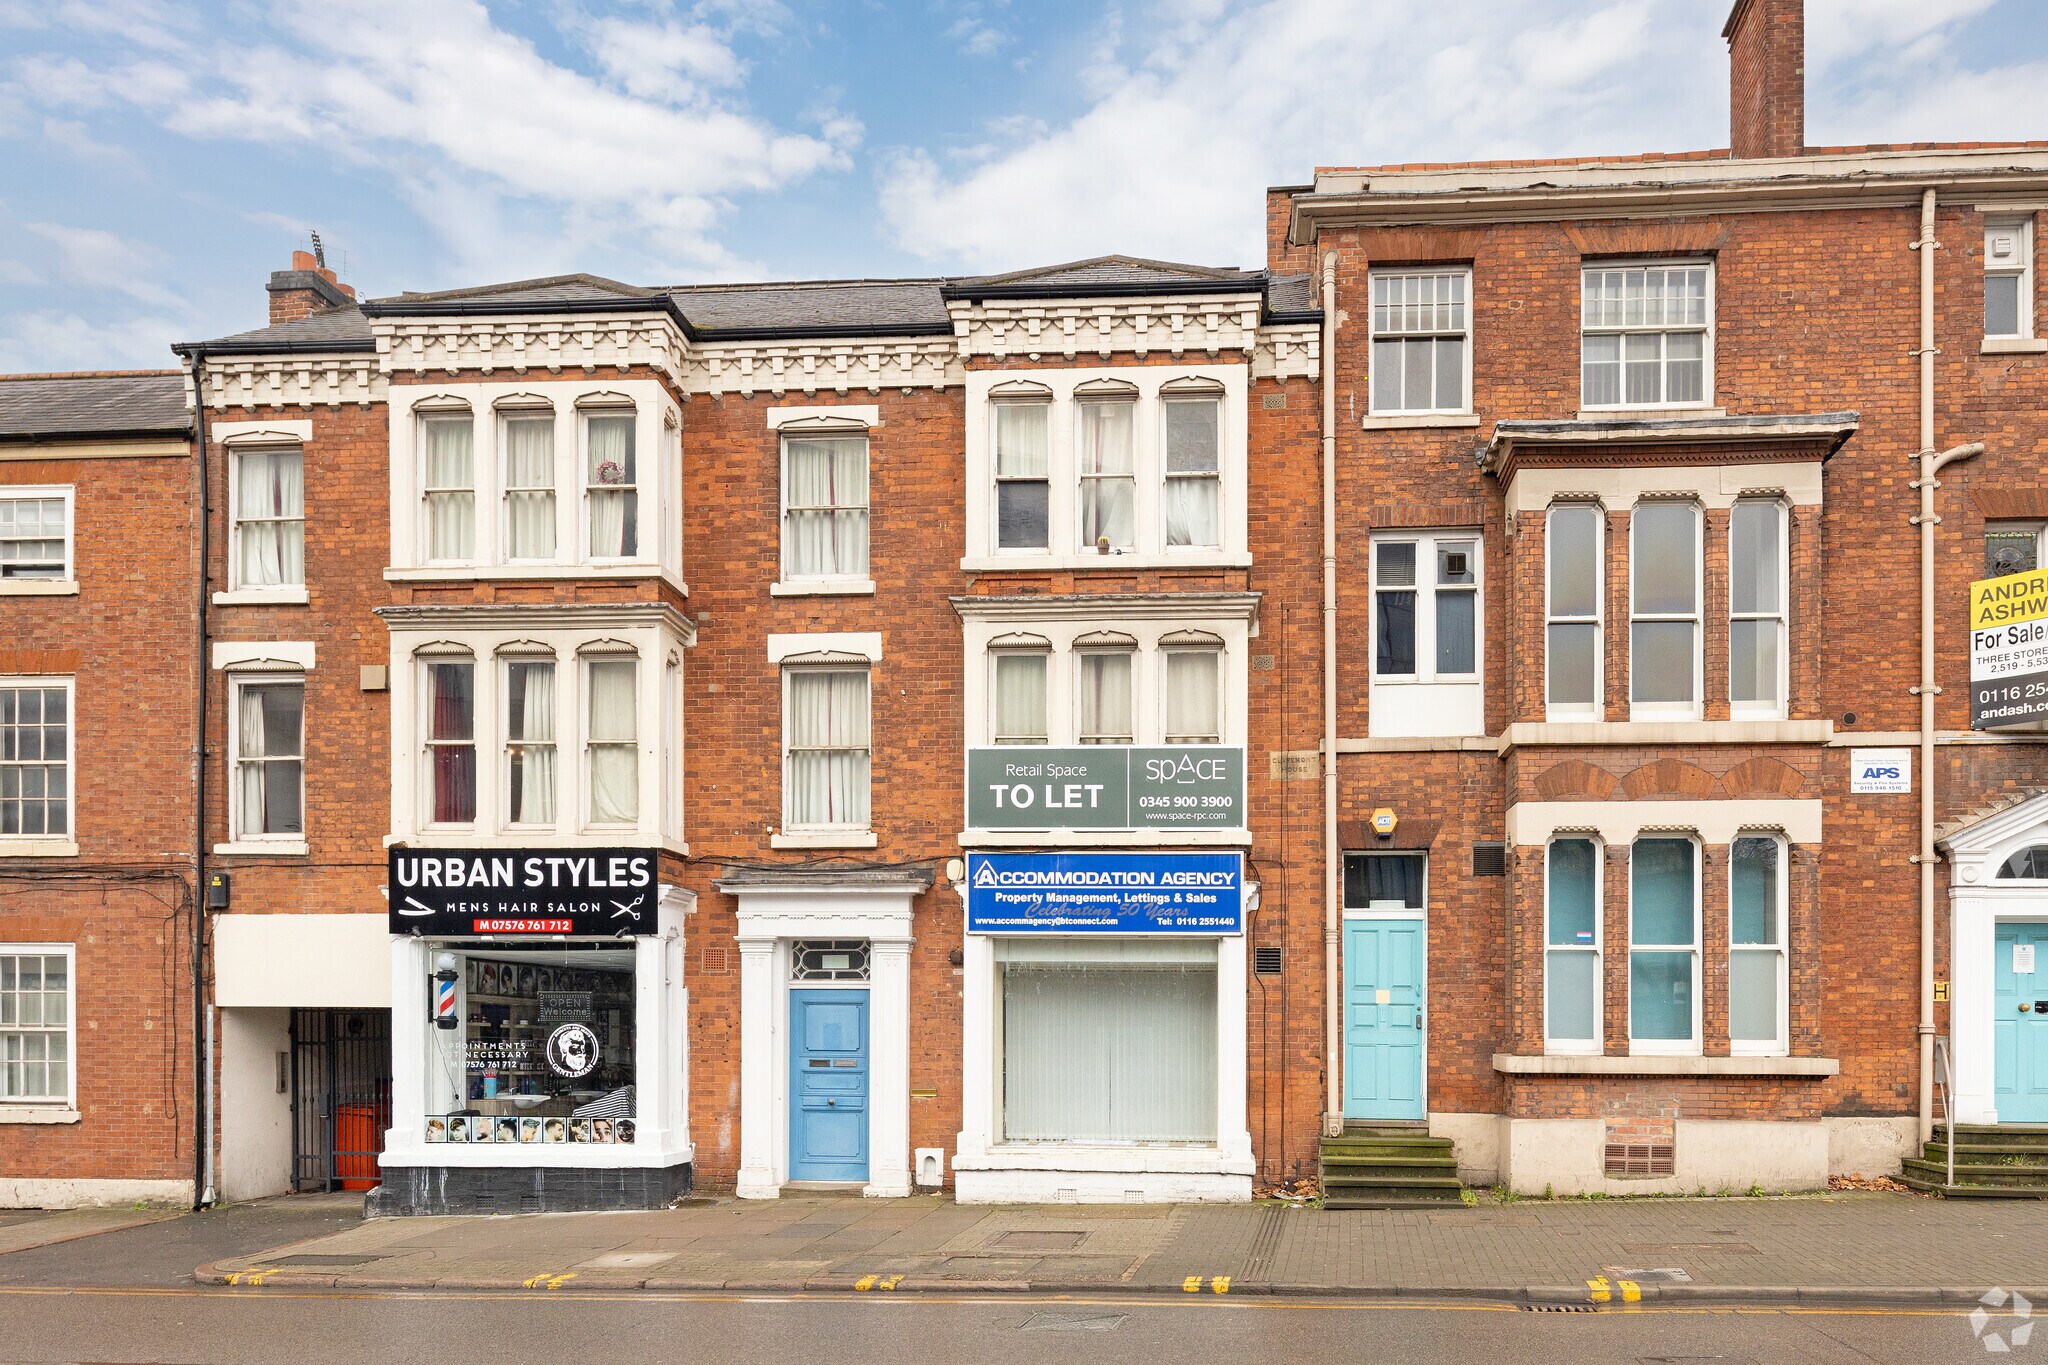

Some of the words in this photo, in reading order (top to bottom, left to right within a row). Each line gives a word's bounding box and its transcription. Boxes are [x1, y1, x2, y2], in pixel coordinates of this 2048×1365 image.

[1979, 576, 2048, 604] ANDR
[1979, 596, 2048, 623] ASHW
[1975, 631, 2002, 650] For
[1976, 652, 2010, 665] THREE
[2014, 646, 2048, 660] STORE
[1980, 686, 2020, 703] 0116
[2025, 682, 2048, 698] 25
[1006, 763, 1042, 776] Retail
[1047, 763, 1087, 779] Space
[1863, 767, 1900, 778] APS
[990, 784, 1035, 809] TO
[1045, 784, 1104, 808] LET
[1139, 796, 1170, 808] 0345
[1173, 796, 1197, 808] 900
[1201, 796, 1232, 808] 3900
[1145, 811, 1226, 821] www.space-rpc.com
[1377, 816, 1391, 826] ADT
[397, 857, 513, 888] URBAN
[523, 857, 650, 888] STYLES
[976, 869, 1155, 886] ACCOMMODATION
[1160, 872, 1236, 886] AGENCY
[995, 892, 1043, 904] Property
[1045, 892, 1122, 904] Management,
[1124, 892, 1171, 904] Lettings
[1173, 893, 1183, 903] &
[1185, 893, 1217, 903] Sales
[446, 902, 490, 913] MENS
[499, 902, 538, 913] HAIR
[547, 902, 601, 913] SALON
[1024, 902, 1112, 919] Celebrating
[1116, 902, 1140, 916] 50
[1142, 902, 1189, 920] Years
[479, 921, 490, 931] M
[491, 921, 525, 931] 07576
[527, 921, 546, 931] 761
[549, 921, 569, 931] 712
[975, 916, 1118, 927] www.accommagency@btconnect.com
[1157, 916, 1173, 926] Tel:
[1176, 916, 1198, 926] 0116
[1199, 916, 1235, 926] 2551440
[549, 998, 581, 1007] OPEN
[544, 1007, 587, 1015] Welcome
[462, 1060, 485, 1068] 07576
[487, 1060, 500, 1068] 761
[502, 1060, 517, 1068] 712
[552, 1062, 594, 1078] GENTLEMAN
